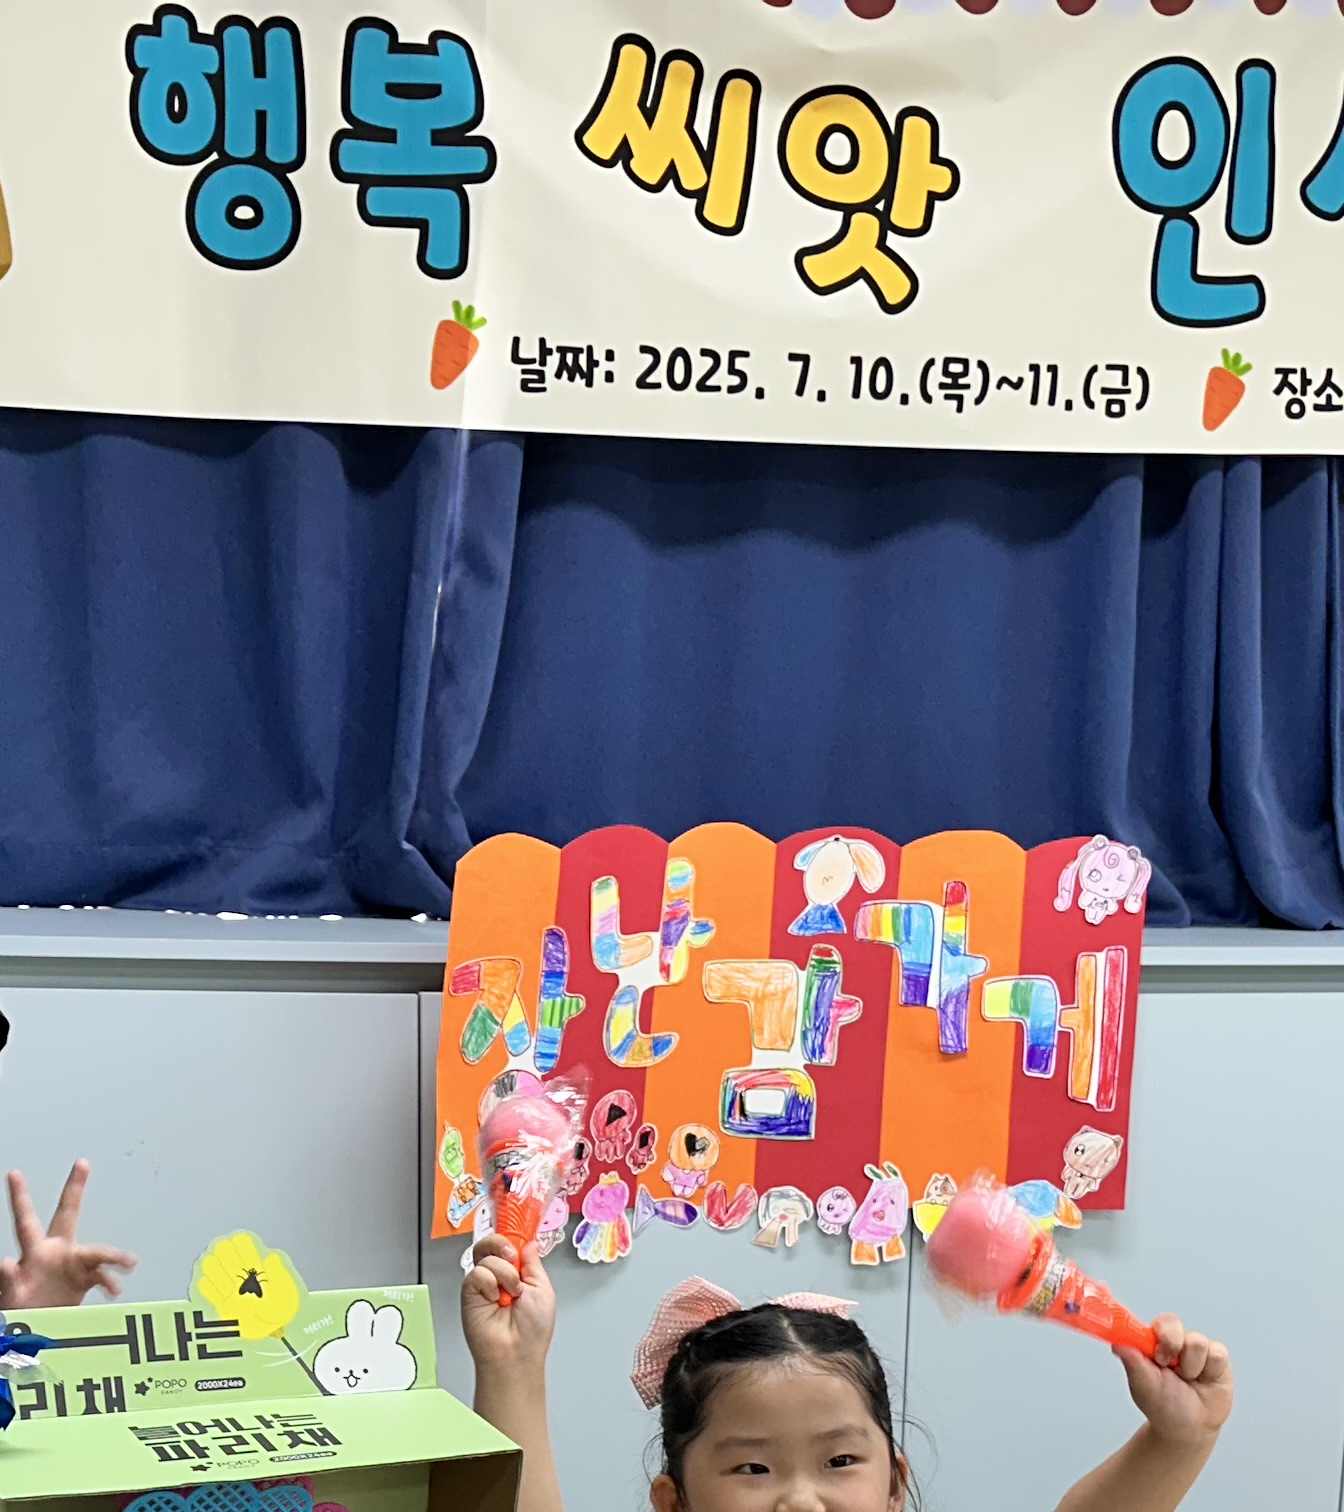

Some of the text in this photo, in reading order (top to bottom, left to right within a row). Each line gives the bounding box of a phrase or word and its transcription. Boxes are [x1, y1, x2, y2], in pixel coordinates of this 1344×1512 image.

[126, 3, 496, 280] 행복
[574, 33, 960, 314] 씨앗
[511, 334, 617, 391] 날짜:
[634, 345, 766, 396] 2025.
[788, 351, 829, 403] 7.
[7, 1311, 244, 1365] 어나는
[17, 1376, 127, 1420] 리채
[155, 1378, 187, 1388] POPO
[128, 1413, 323, 1440] 늘어나는
[144, 1427, 343, 1462] 파리채
